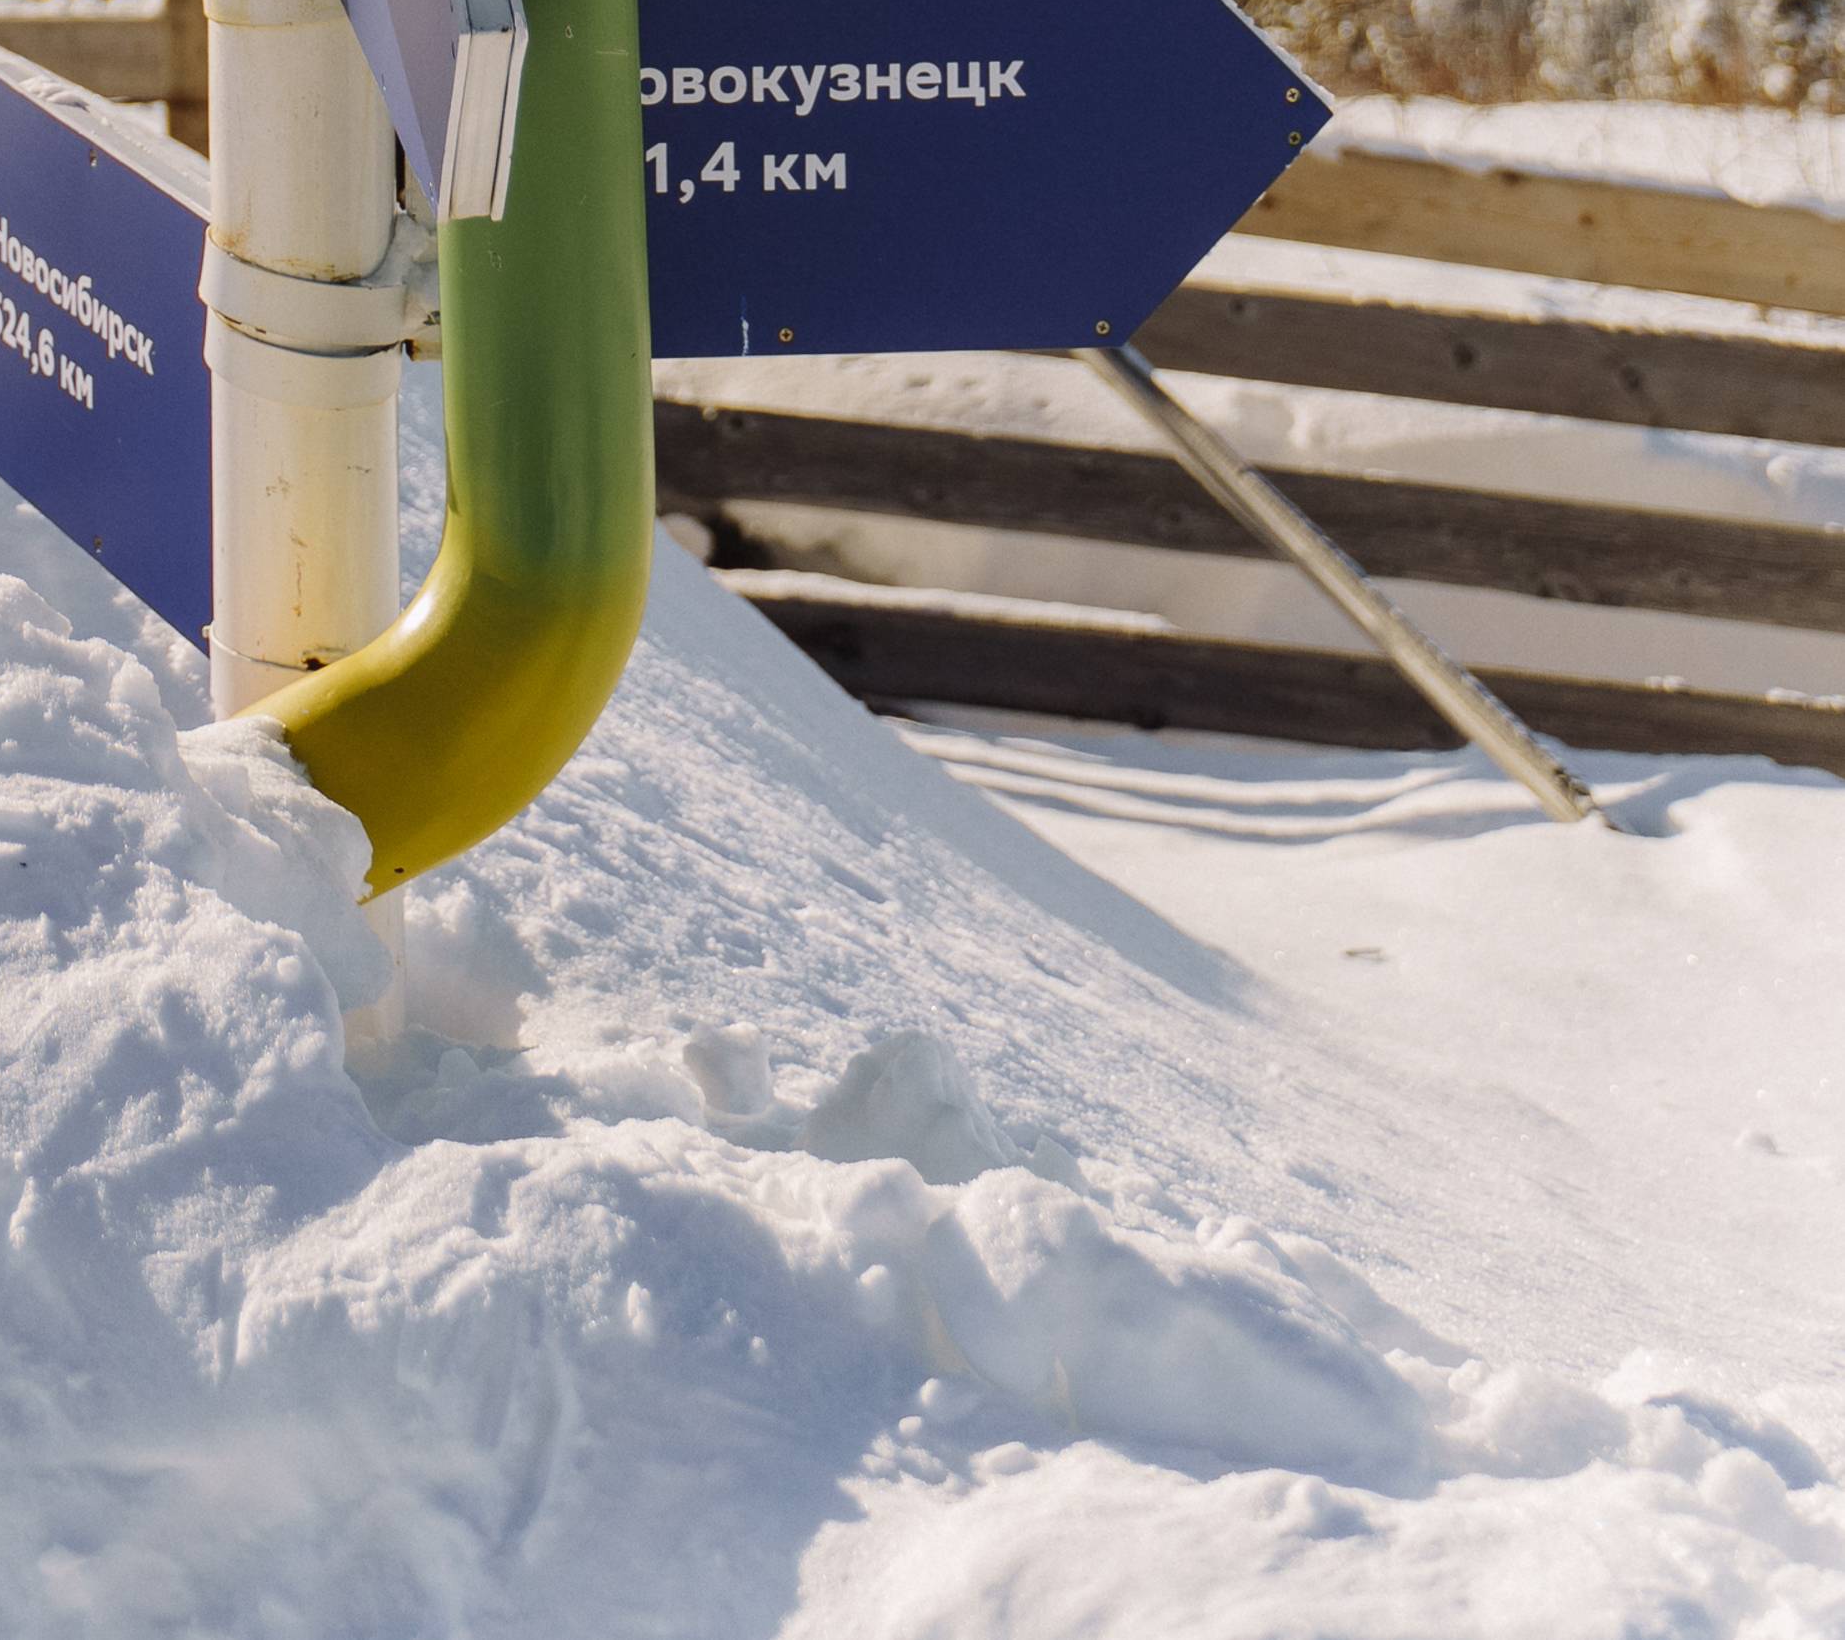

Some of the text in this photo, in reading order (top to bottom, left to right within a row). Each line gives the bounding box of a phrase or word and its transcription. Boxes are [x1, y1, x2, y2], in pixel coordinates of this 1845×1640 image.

[638, 59, 1026, 116] овокузнецк
[644, 141, 847, 204] 1,4 км
[60, 353, 94, 410] км
